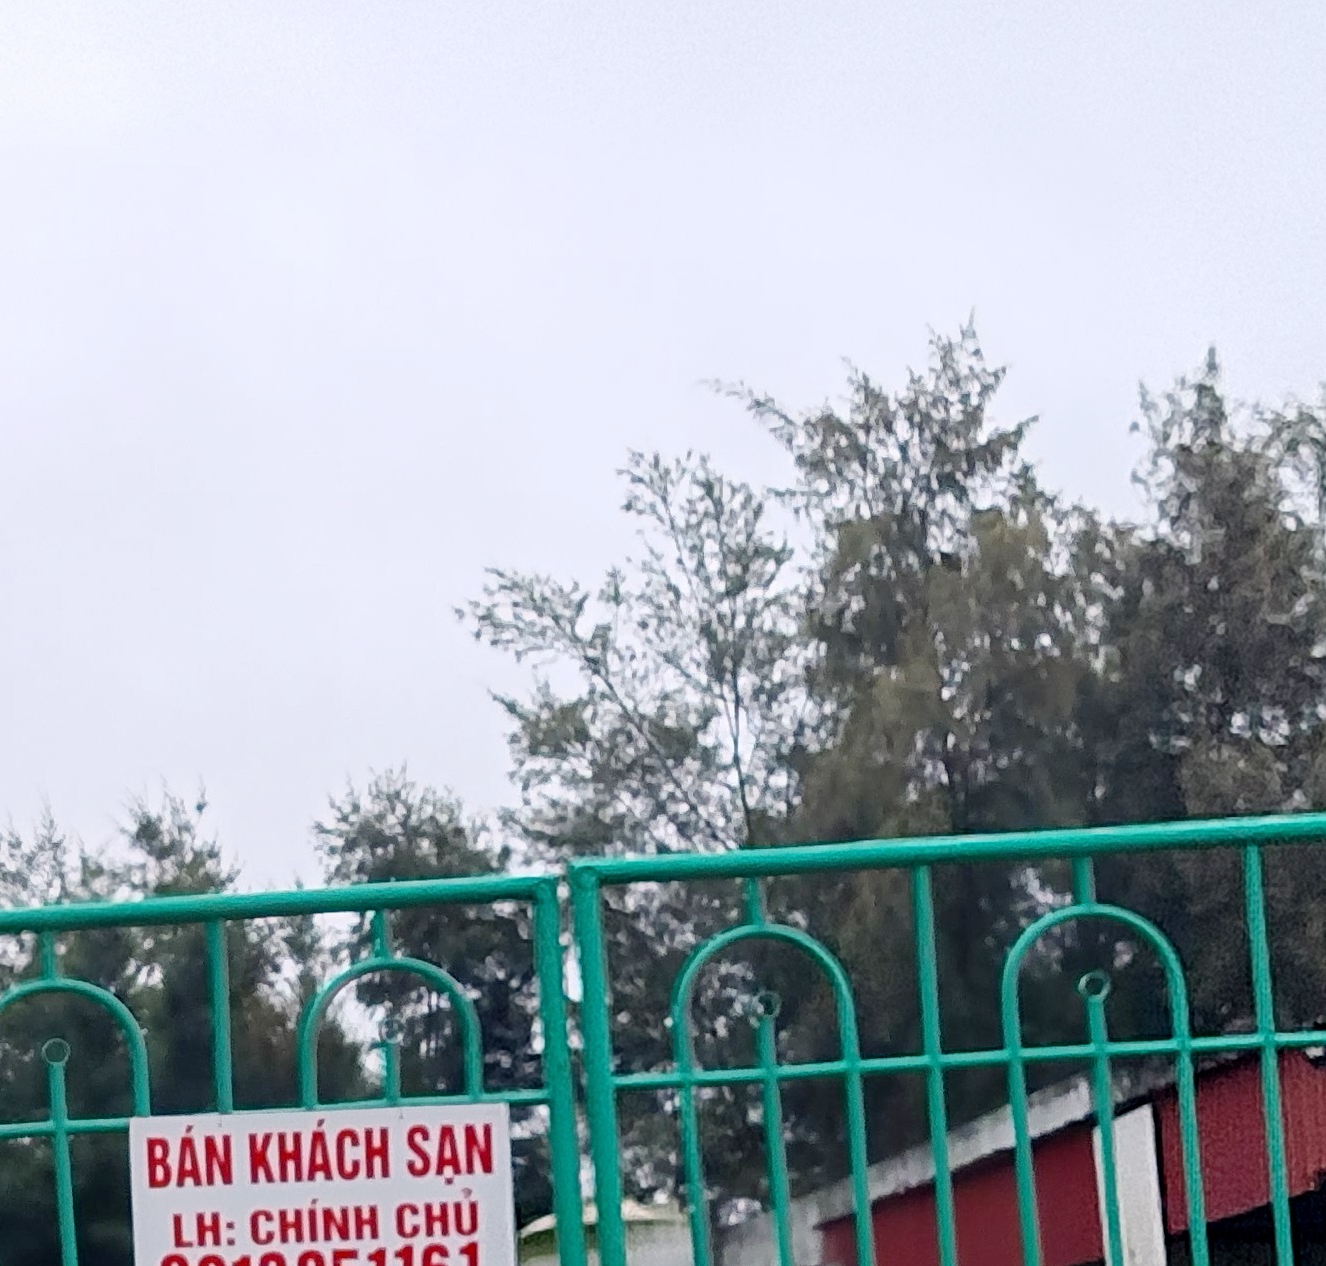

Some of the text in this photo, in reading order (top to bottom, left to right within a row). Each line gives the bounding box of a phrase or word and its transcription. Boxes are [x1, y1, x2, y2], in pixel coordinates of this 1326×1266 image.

[146, 1118, 494, 1189] BÁN KHÁCH SẠN
[172, 1187, 479, 1249] LH: CHÍNH CHỦ
